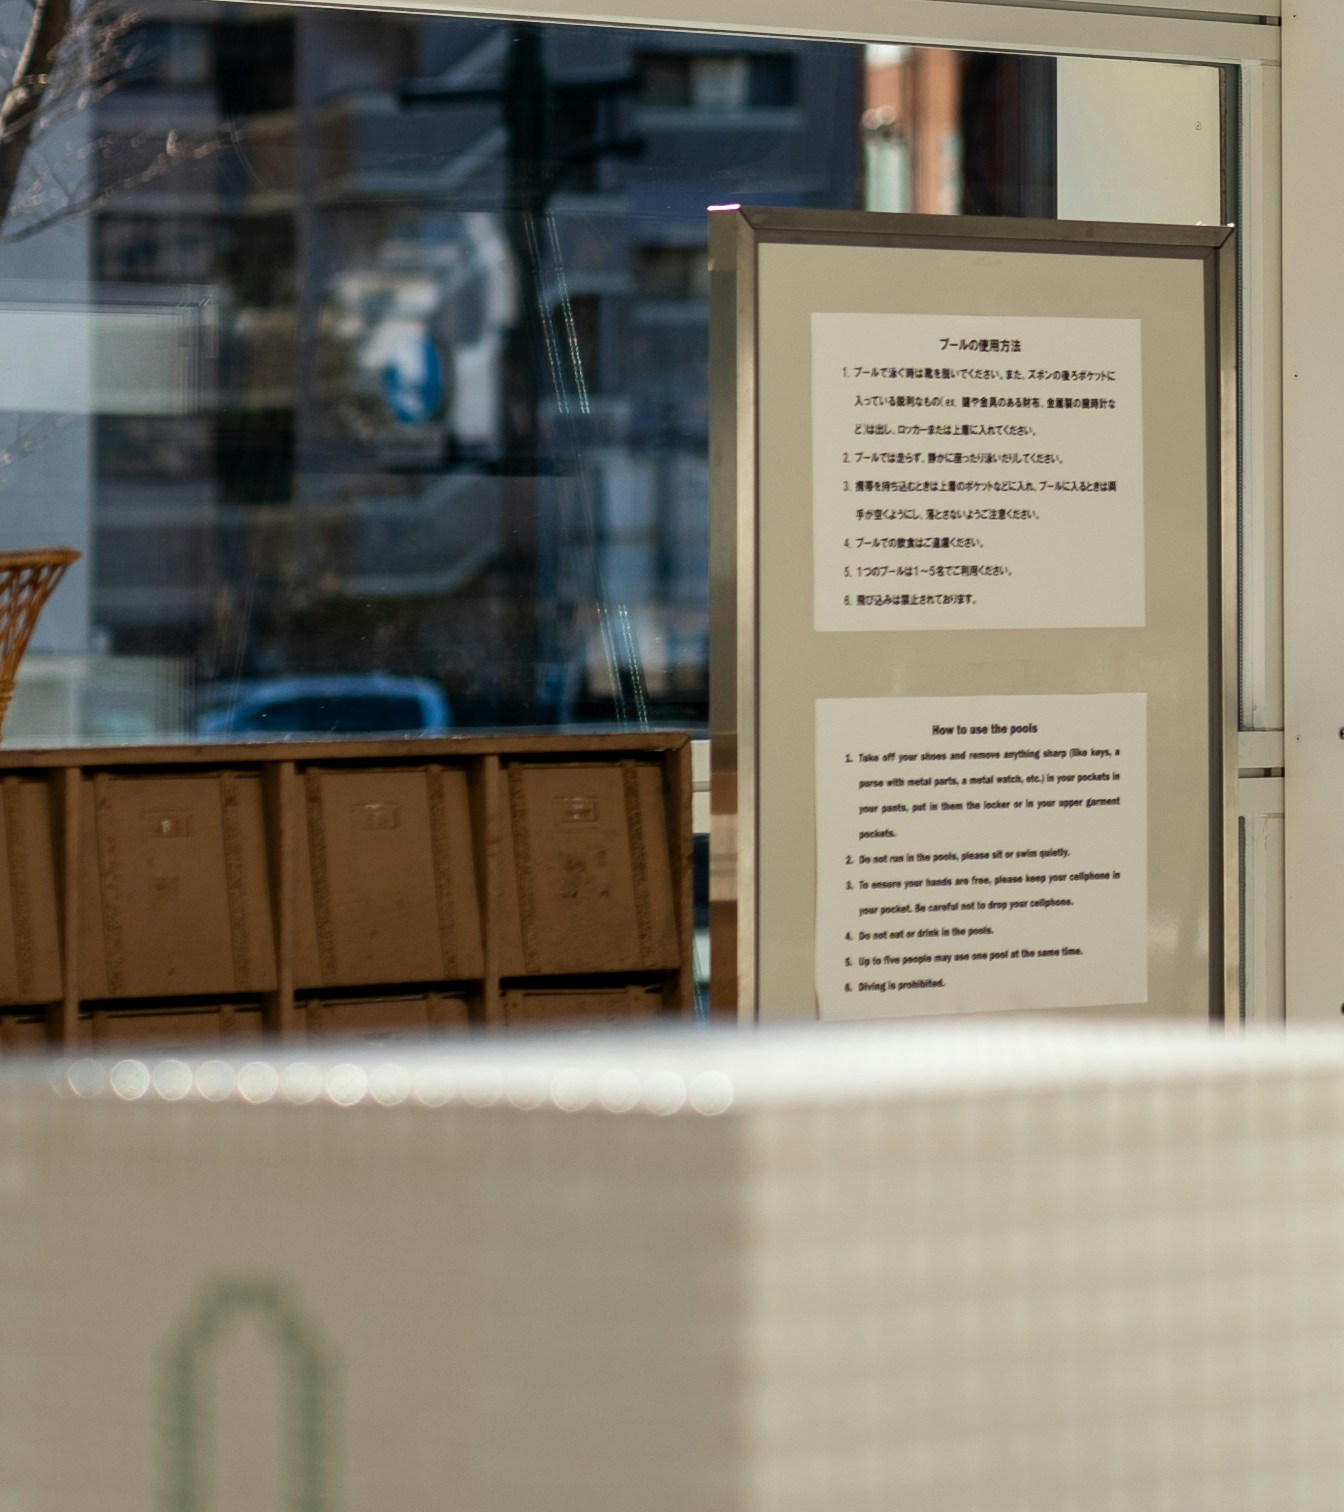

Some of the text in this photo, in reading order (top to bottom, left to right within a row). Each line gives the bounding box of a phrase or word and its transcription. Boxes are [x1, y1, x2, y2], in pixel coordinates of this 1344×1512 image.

[932, 722, 1038, 736] How to use the pools
[858, 753, 879, 763] Take
[881, 751, 896, 762] off
[898, 753, 918, 764] your
[920, 752, 947, 761] shoes
[949, 751, 966, 761] and
[968, 751, 1000, 760] remove
[1003, 749, 1040, 761] anything
[1042, 748, 1067, 759] sharp
[1114, 748, 1120, 757] a
[858, 780, 884, 790] purse
[886, 777, 904, 787] with
[906, 777, 932, 787] metal
[961, 777, 967, 785] a
[969, 775, 994, 785] metal
[1046, 773, 1054, 783] in
[1056, 774, 1075, 785] your
[1076, 772, 1110, 784] pockets
[1112, 771, 1120, 781] in
[858, 805, 878, 816] your
[911, 802, 926, 813] put
[929, 802, 938, 811] in
[940, 801, 963, 811] them
[966, 800, 980, 810] the
[983, 800, 1010, 810] locker
[1012, 801, 1022, 809] or
[1025, 798, 1034, 808] in
[1036, 800, 1056, 810] your
[1058, 799, 1083, 809] upper
[1085, 796, 1120, 809] garment
[858, 854, 871, 865] Do
[872, 854, 888, 864] not
[889, 855, 904, 863] run
[905, 853, 914, 863] in
[915, 852, 931, 862] the
[960, 851, 990, 862] please
[991, 849, 1003, 860] sit
[1004, 851, 1014, 859] or
[1015, 848, 1037, 859] swim
[858, 879, 869, 890] To
[870, 880, 902, 890] ensure
[903, 879, 924, 890] your
[925, 877, 952, 887] hands
[954, 878, 969, 886] are
[994, 874, 1023, 886] please
[1024, 874, 1046, 885] keep
[1048, 873, 1067, 885] your
[1068, 871, 1110, 883] cellphone
[1112, 870, 1120, 880] in
[858, 906, 878, 917] your
[914, 903, 926, 913] Be
[927, 901, 959, 912] careful
[960, 901, 975, 911] not
[976, 901, 986, 910] to
[987, 900, 1008, 911] drop
[1008, 900, 1028, 911] your
[858, 930, 871, 941] Do
[872, 930, 888, 940] not
[888, 929, 904, 940] eat
[905, 930, 916, 939] or
[916, 928, 939, 938] drink
[941, 927, 950, 937] in
[951, 927, 966, 937] the
[858, 956, 870, 968] Up
[871, 956, 882, 966] to
[883, 955, 900, 965] five
[902, 954, 932, 966] people
[933, 954, 952, 964] may
[953, 953, 970, 962] use
[970, 952, 988, 961] one
[989, 949, 1008, 962] pool
[1010, 949, 1020, 959] at
[1020, 948, 1035, 959] the
[1036, 949, 1060, 958] same
[858, 981, 886, 993] Diving
[887, 980, 896, 991] is
